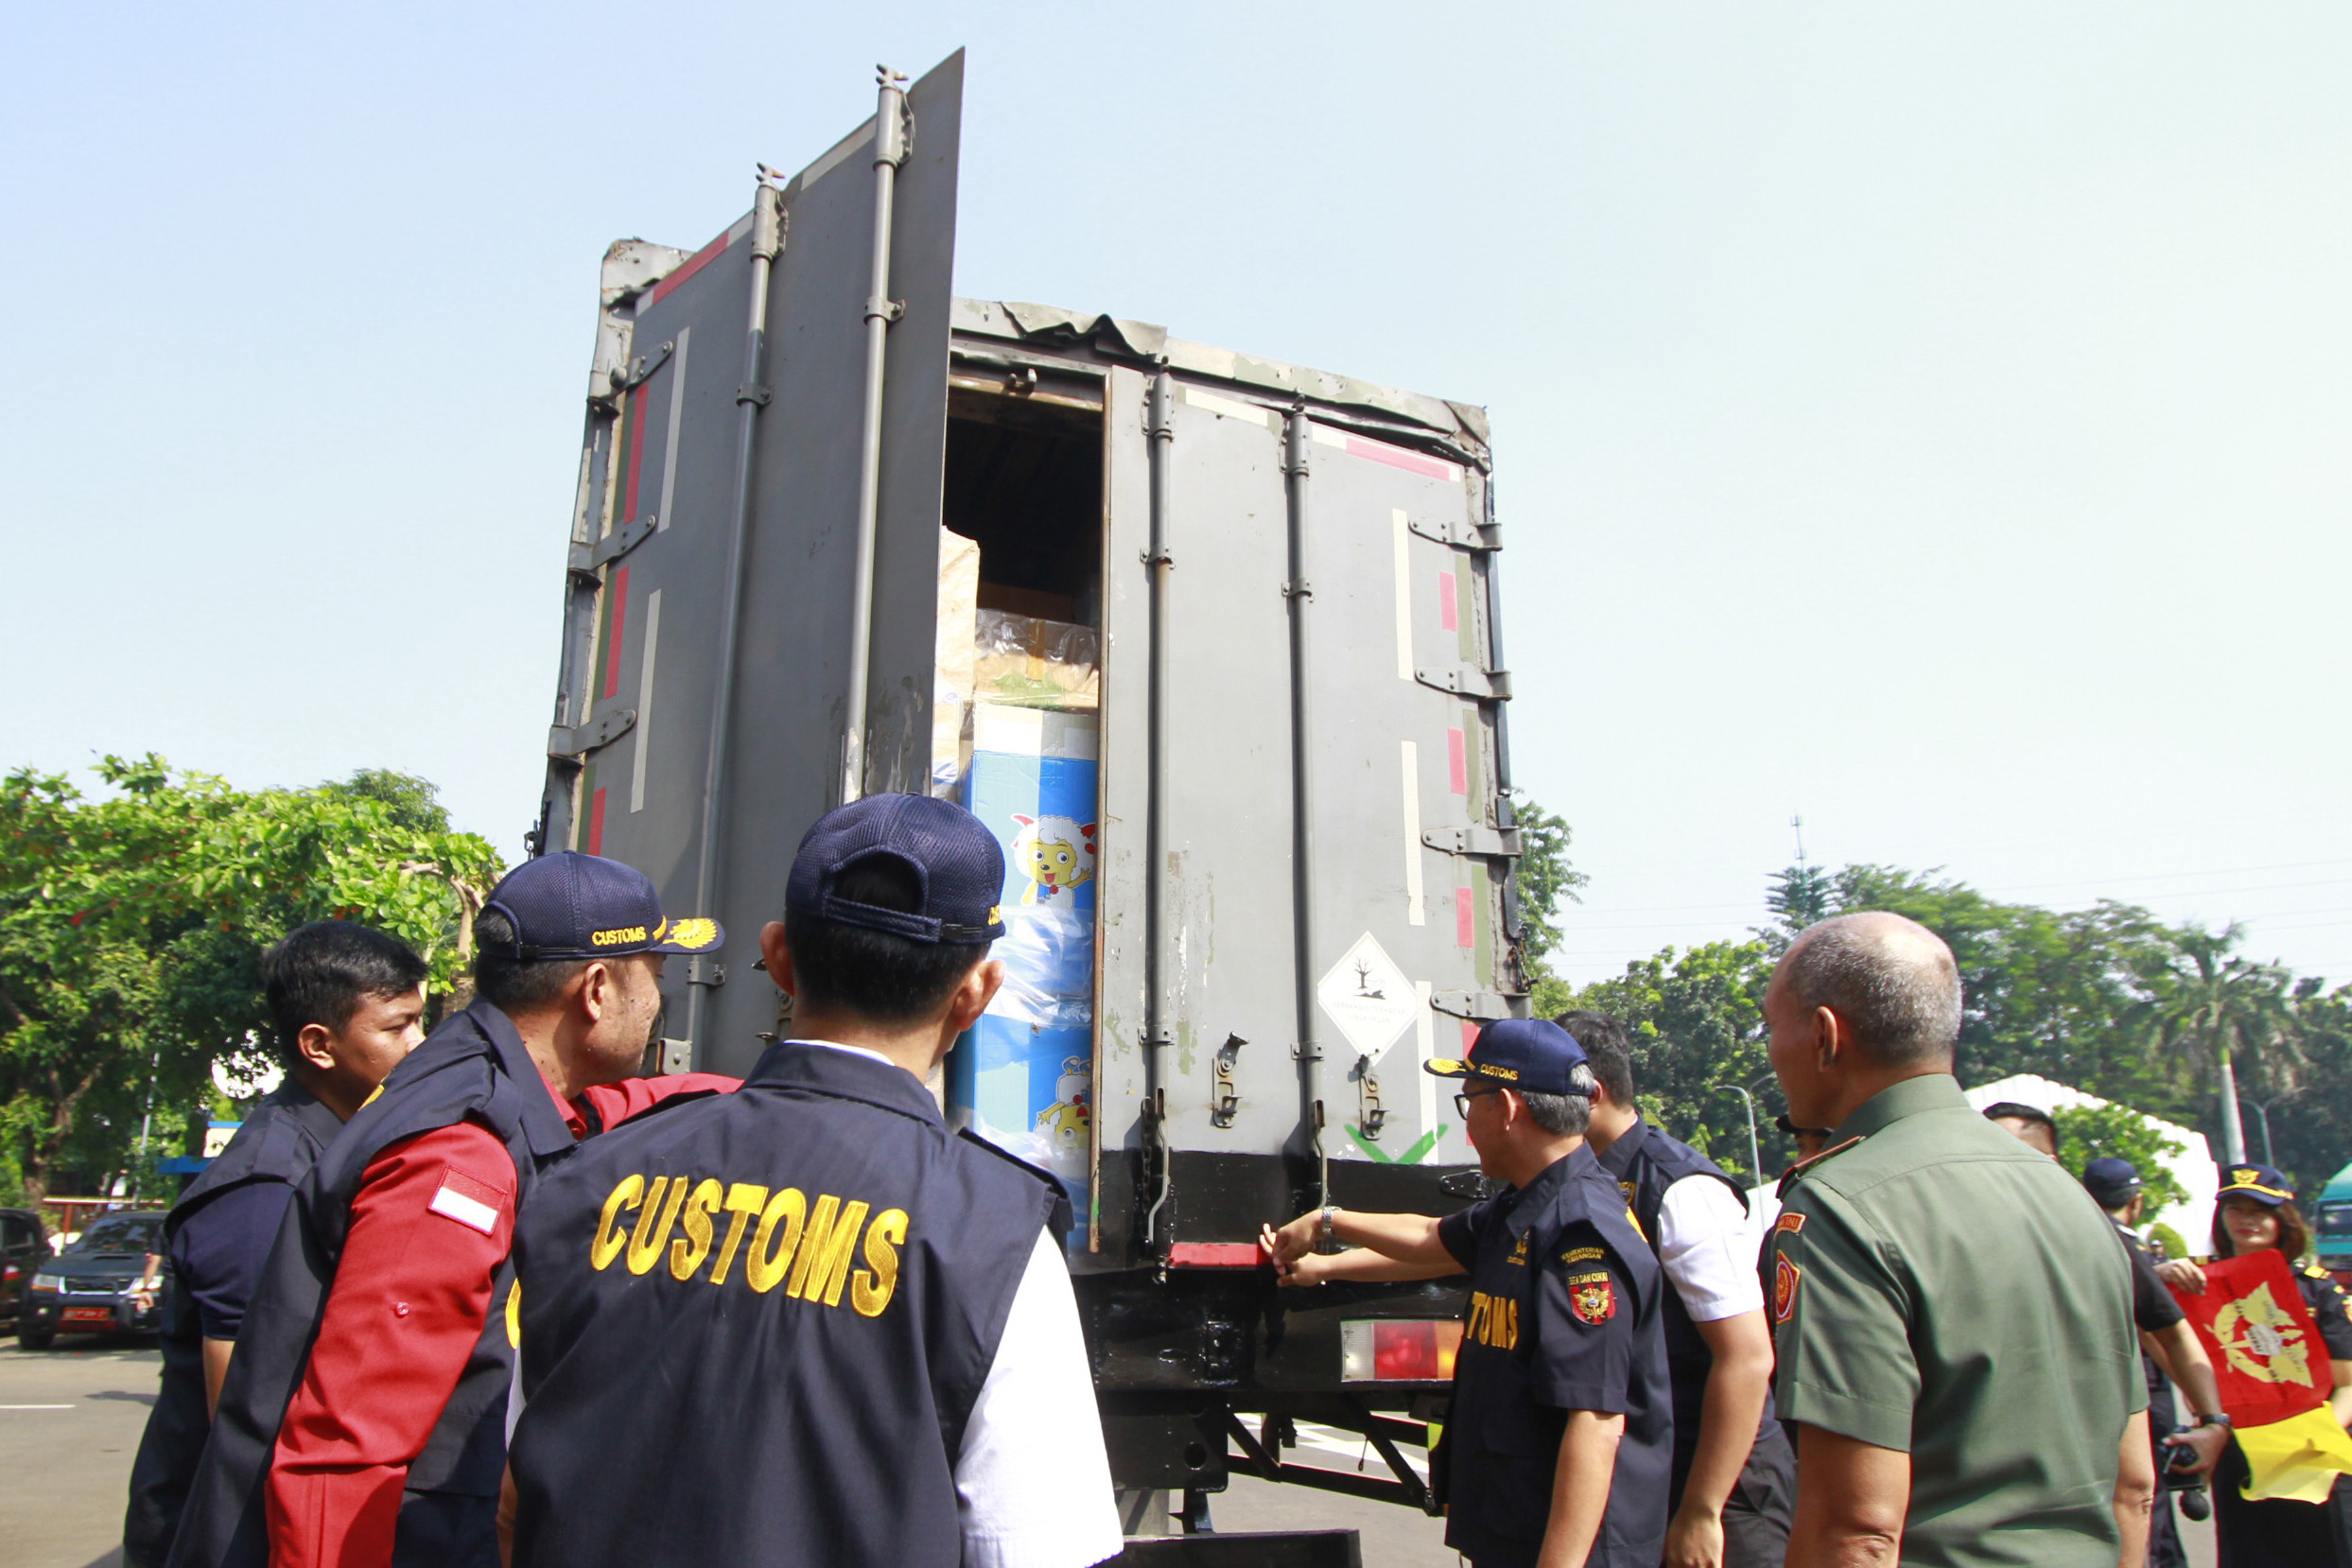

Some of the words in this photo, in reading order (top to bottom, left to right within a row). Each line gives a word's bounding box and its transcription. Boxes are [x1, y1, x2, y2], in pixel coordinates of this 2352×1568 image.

[592, 926, 647, 946] CUSTOMS
[1480, 1063, 1518, 1081] CUSTOMS
[590, 1174, 909, 1317] CUSTOMS
[1467, 1291, 1519, 1350] TOMS
